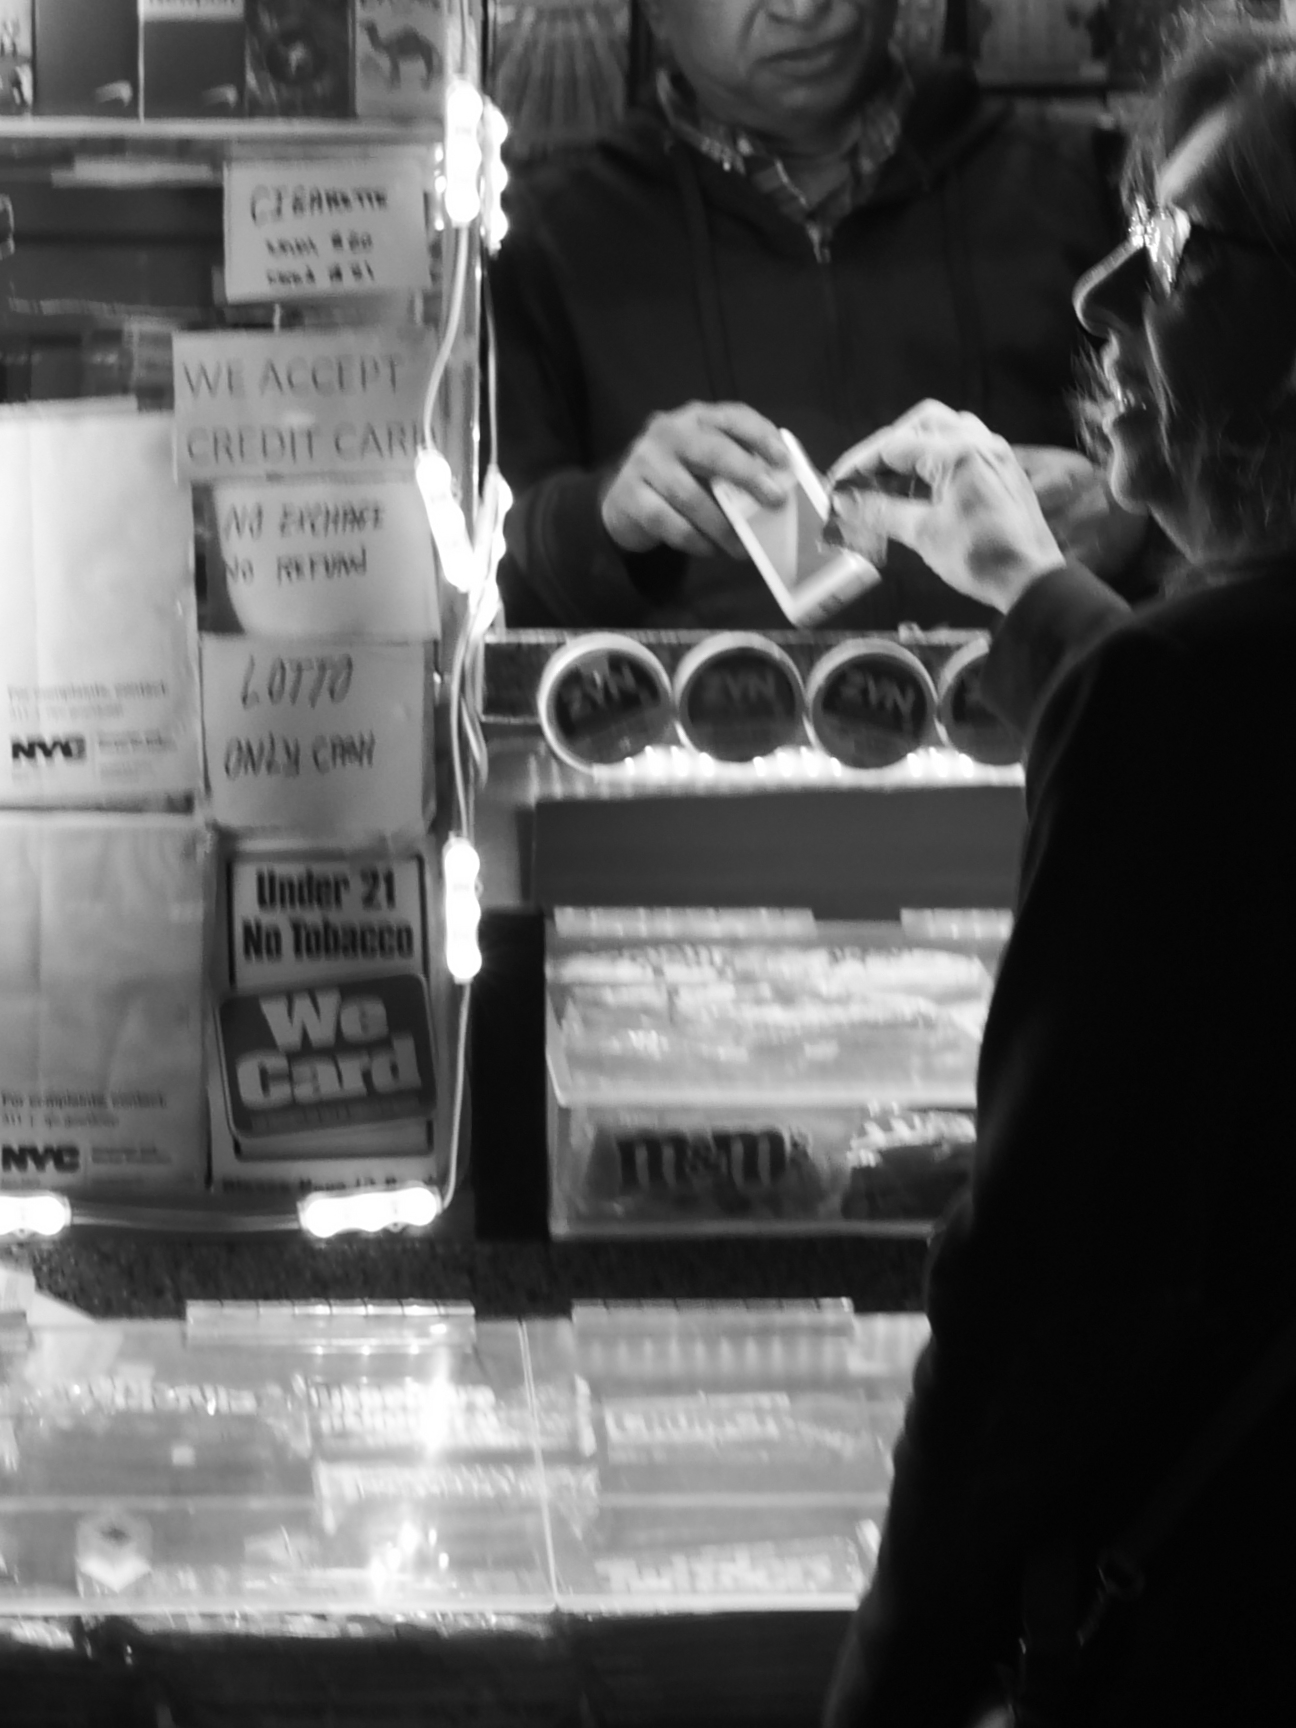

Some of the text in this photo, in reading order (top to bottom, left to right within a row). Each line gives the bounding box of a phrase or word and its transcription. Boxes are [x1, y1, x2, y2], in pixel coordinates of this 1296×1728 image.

[183, 354, 399, 397] WE ACCEPT
[186, 427, 320, 465] CREDIT
[256, 867, 396, 913] Under 21
[242, 917, 415, 963] No Tobacco
[259, 987, 389, 1052] We
[237, 1031, 421, 1110] Card
[1, 1144, 81, 1172] NYC
